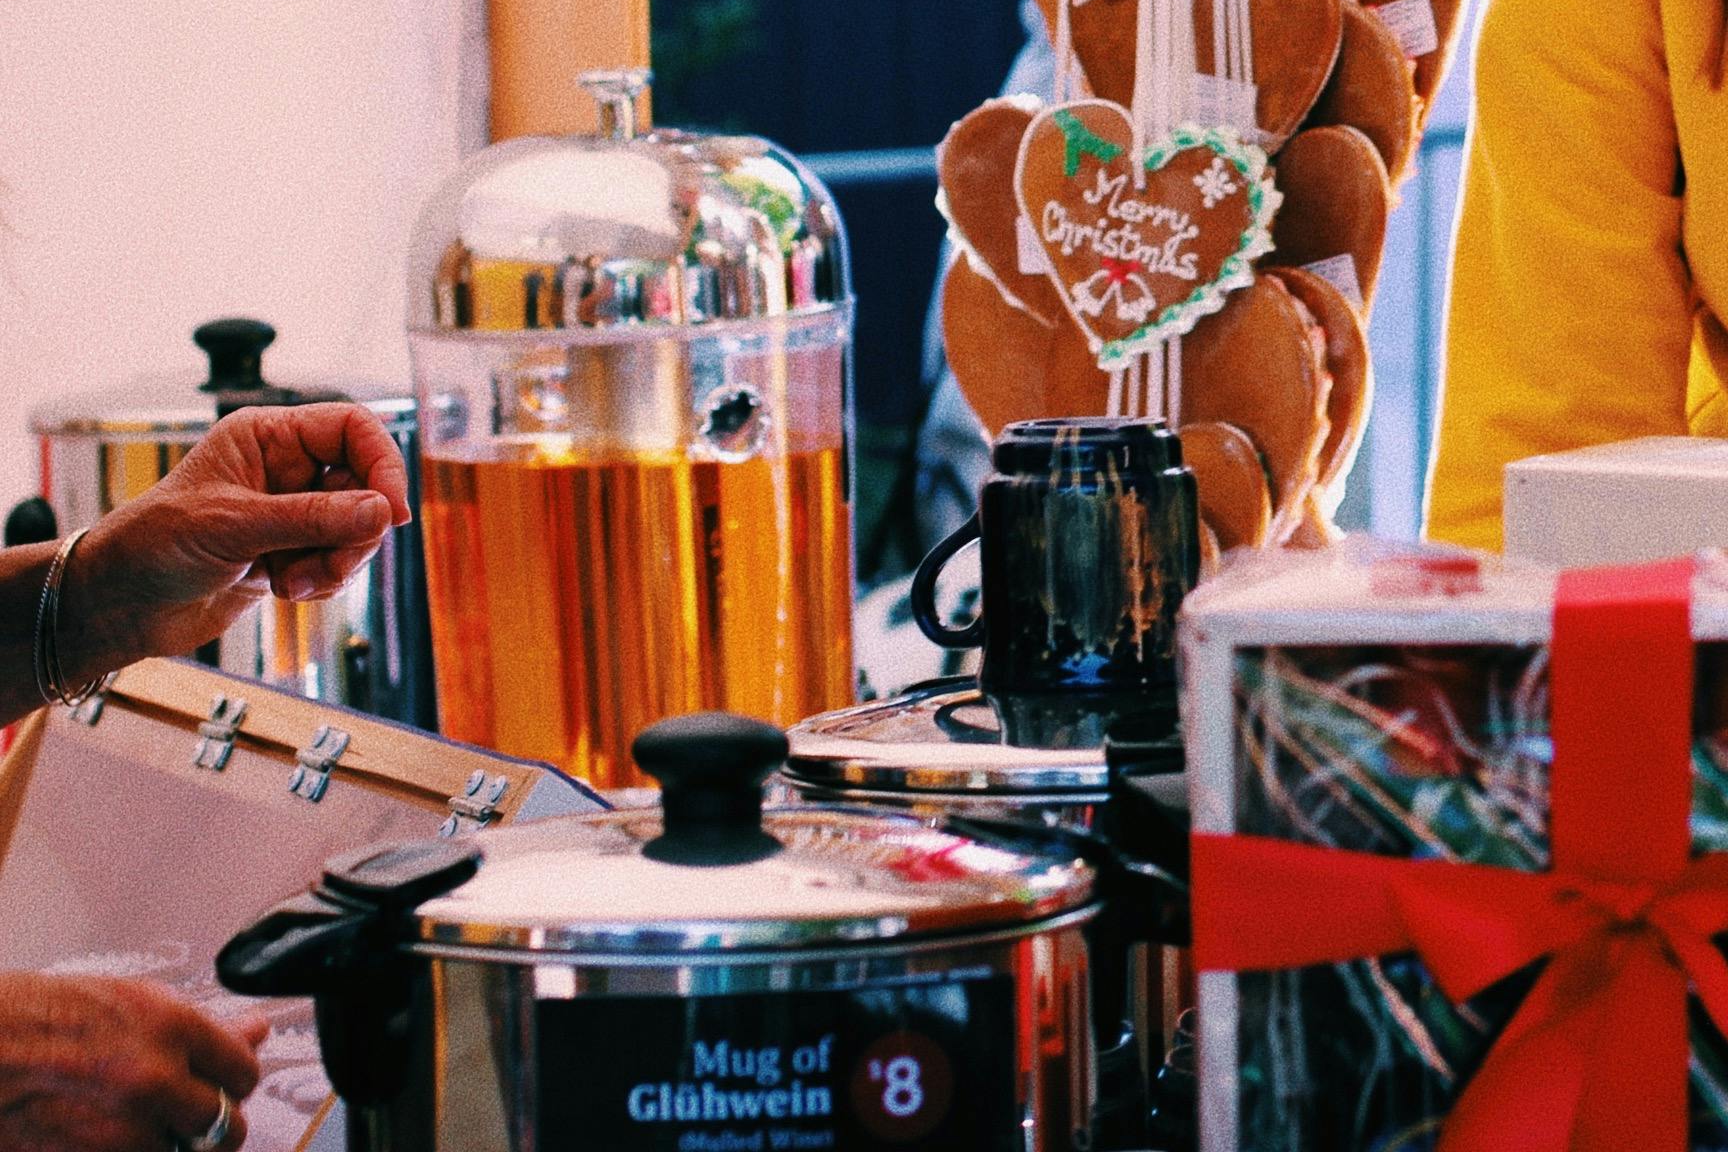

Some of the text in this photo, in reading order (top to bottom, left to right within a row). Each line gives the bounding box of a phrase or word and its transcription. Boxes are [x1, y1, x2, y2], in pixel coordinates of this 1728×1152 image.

[1082, 168, 1200, 240] Merry
[1042, 200, 1199, 281] Christmas
[693, 1033, 837, 1087] Mug of
[626, 1081, 832, 1122] Glühwein
